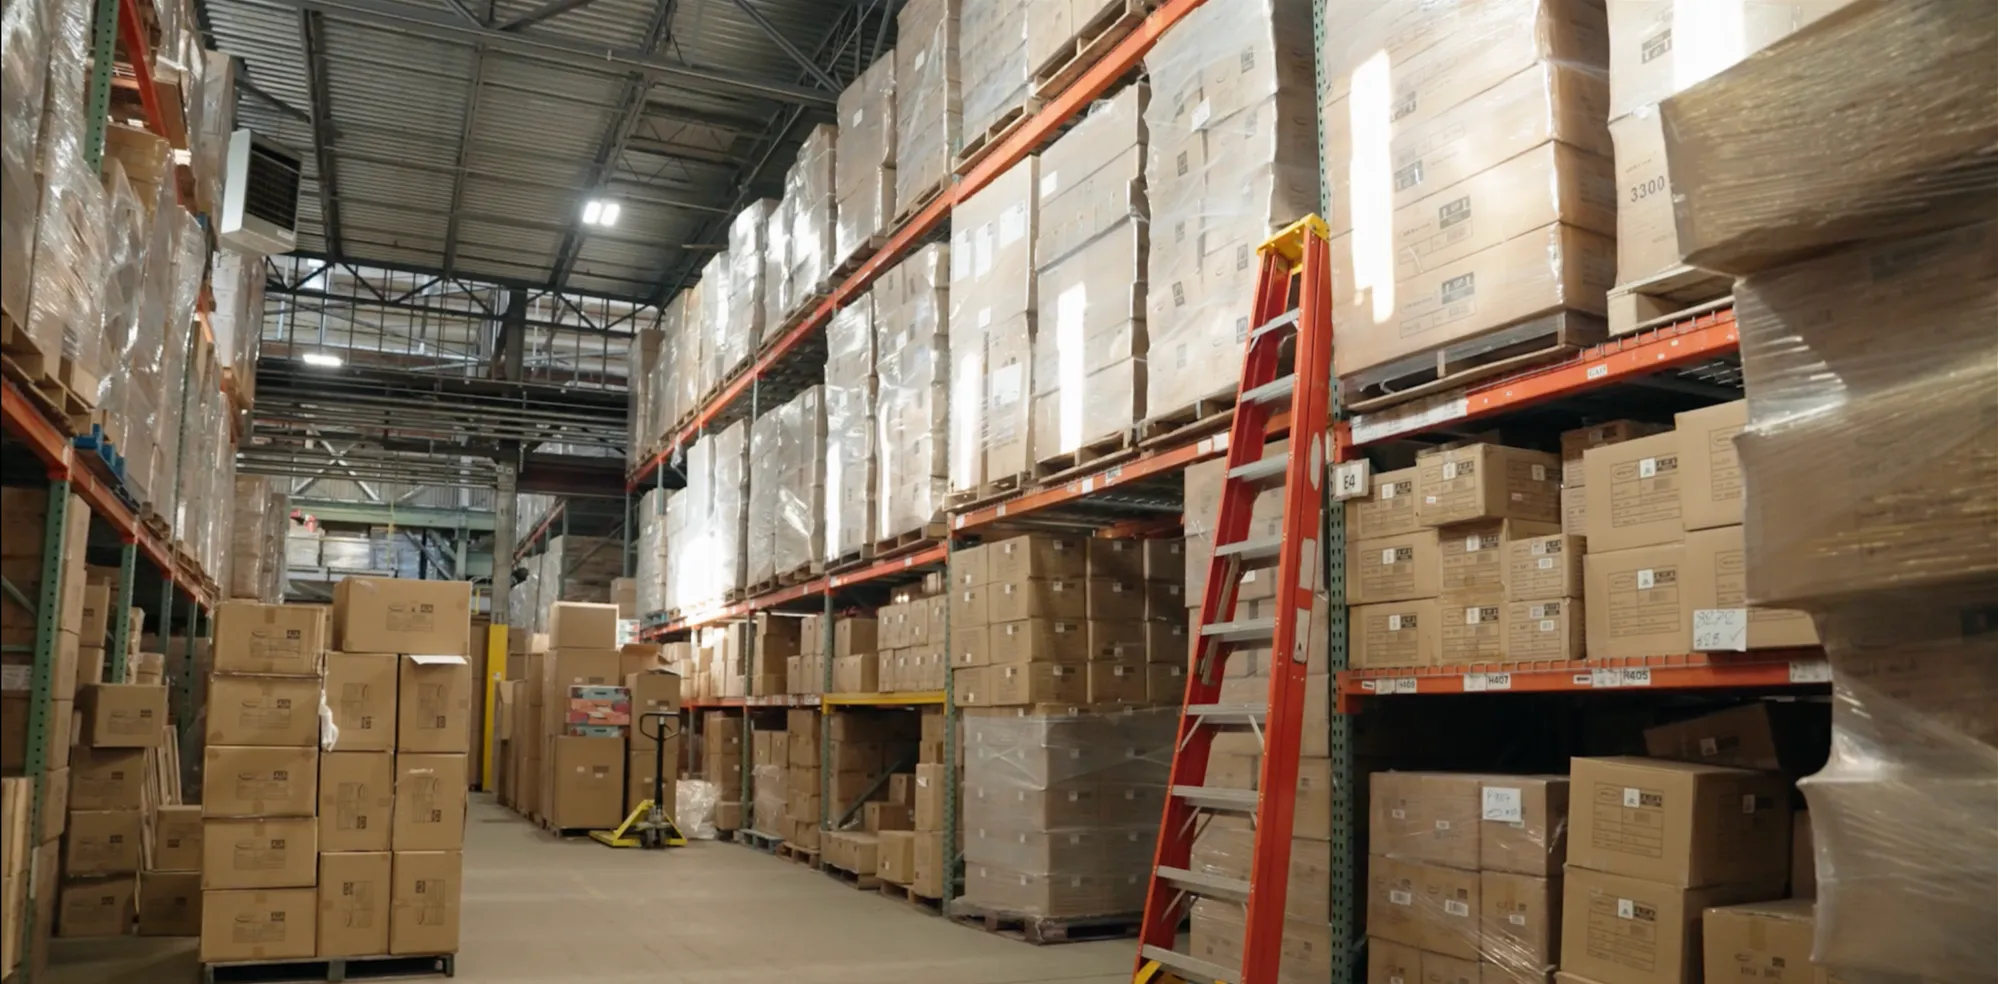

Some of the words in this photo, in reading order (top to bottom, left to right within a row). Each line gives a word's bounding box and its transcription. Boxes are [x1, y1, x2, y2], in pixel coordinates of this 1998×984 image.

[1630, 175, 1665, 203] 3300
[1343, 474, 1356, 490] E4
[1488, 674, 1509, 686] H407
